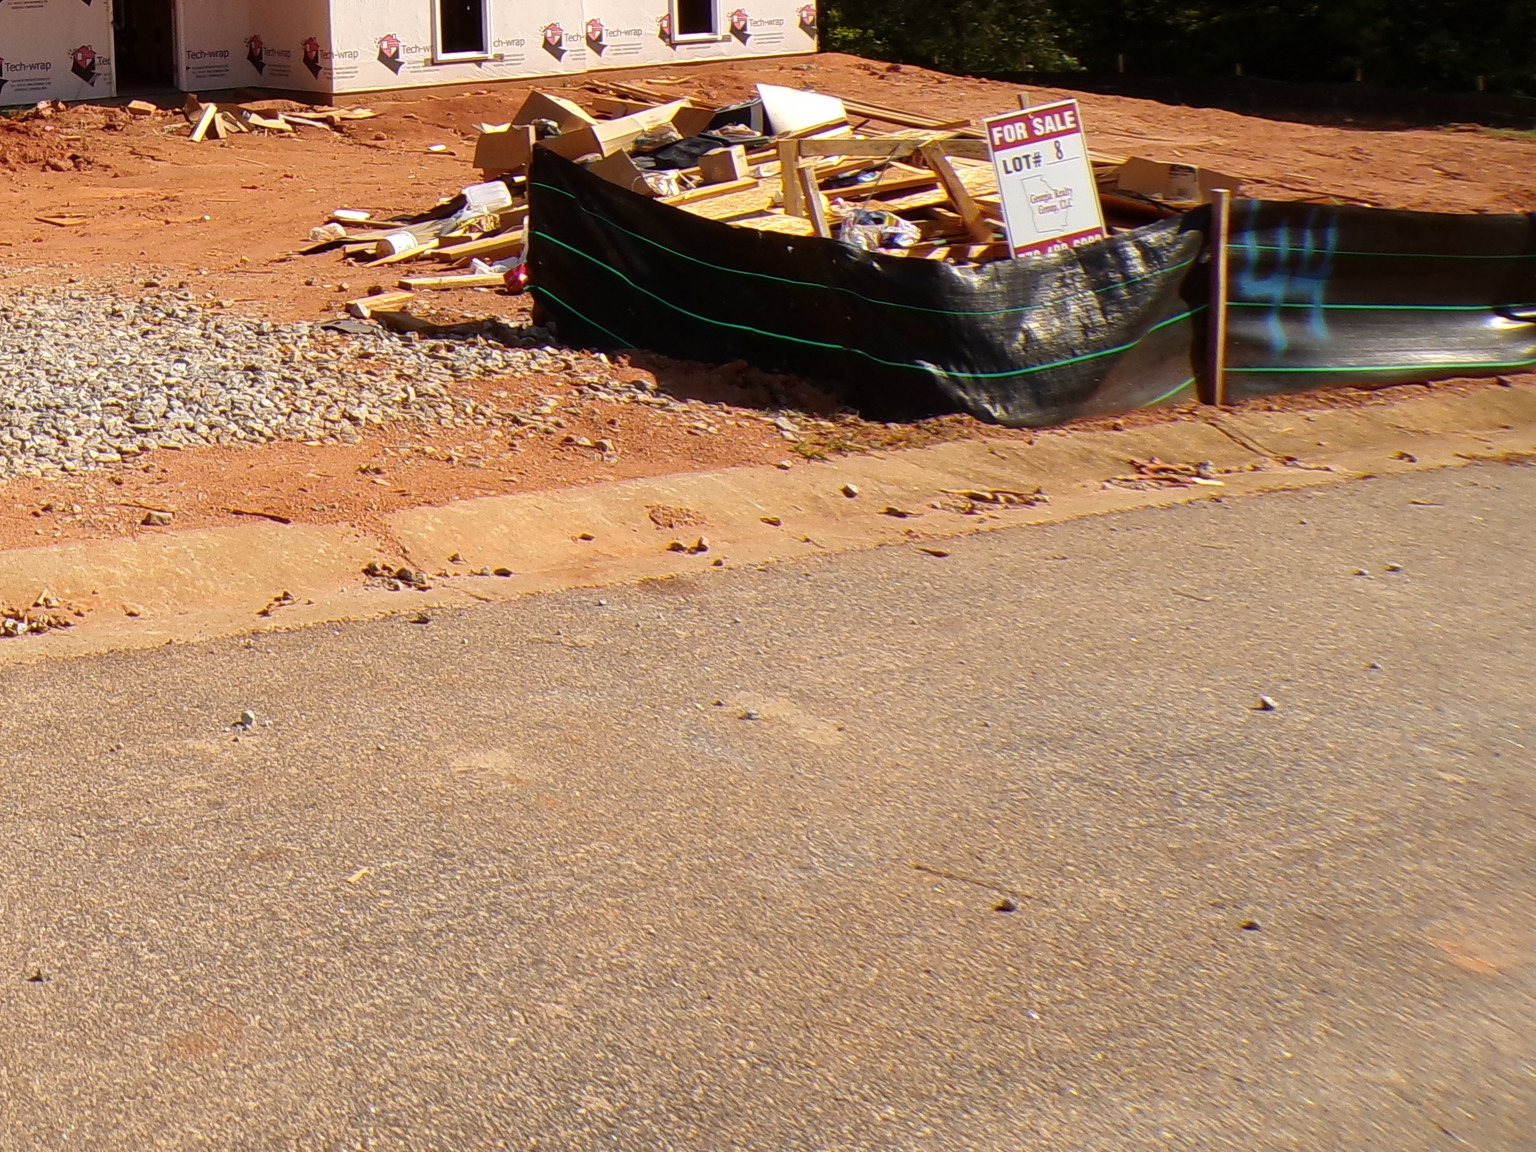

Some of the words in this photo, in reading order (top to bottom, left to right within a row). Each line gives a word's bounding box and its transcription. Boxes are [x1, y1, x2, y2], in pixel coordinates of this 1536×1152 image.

[992, 122, 1029, 146] FOR
[1032, 110, 1077, 136] SALE
[1002, 152, 1042, 175] LOT#
[1054, 140, 1064, 160] 8
